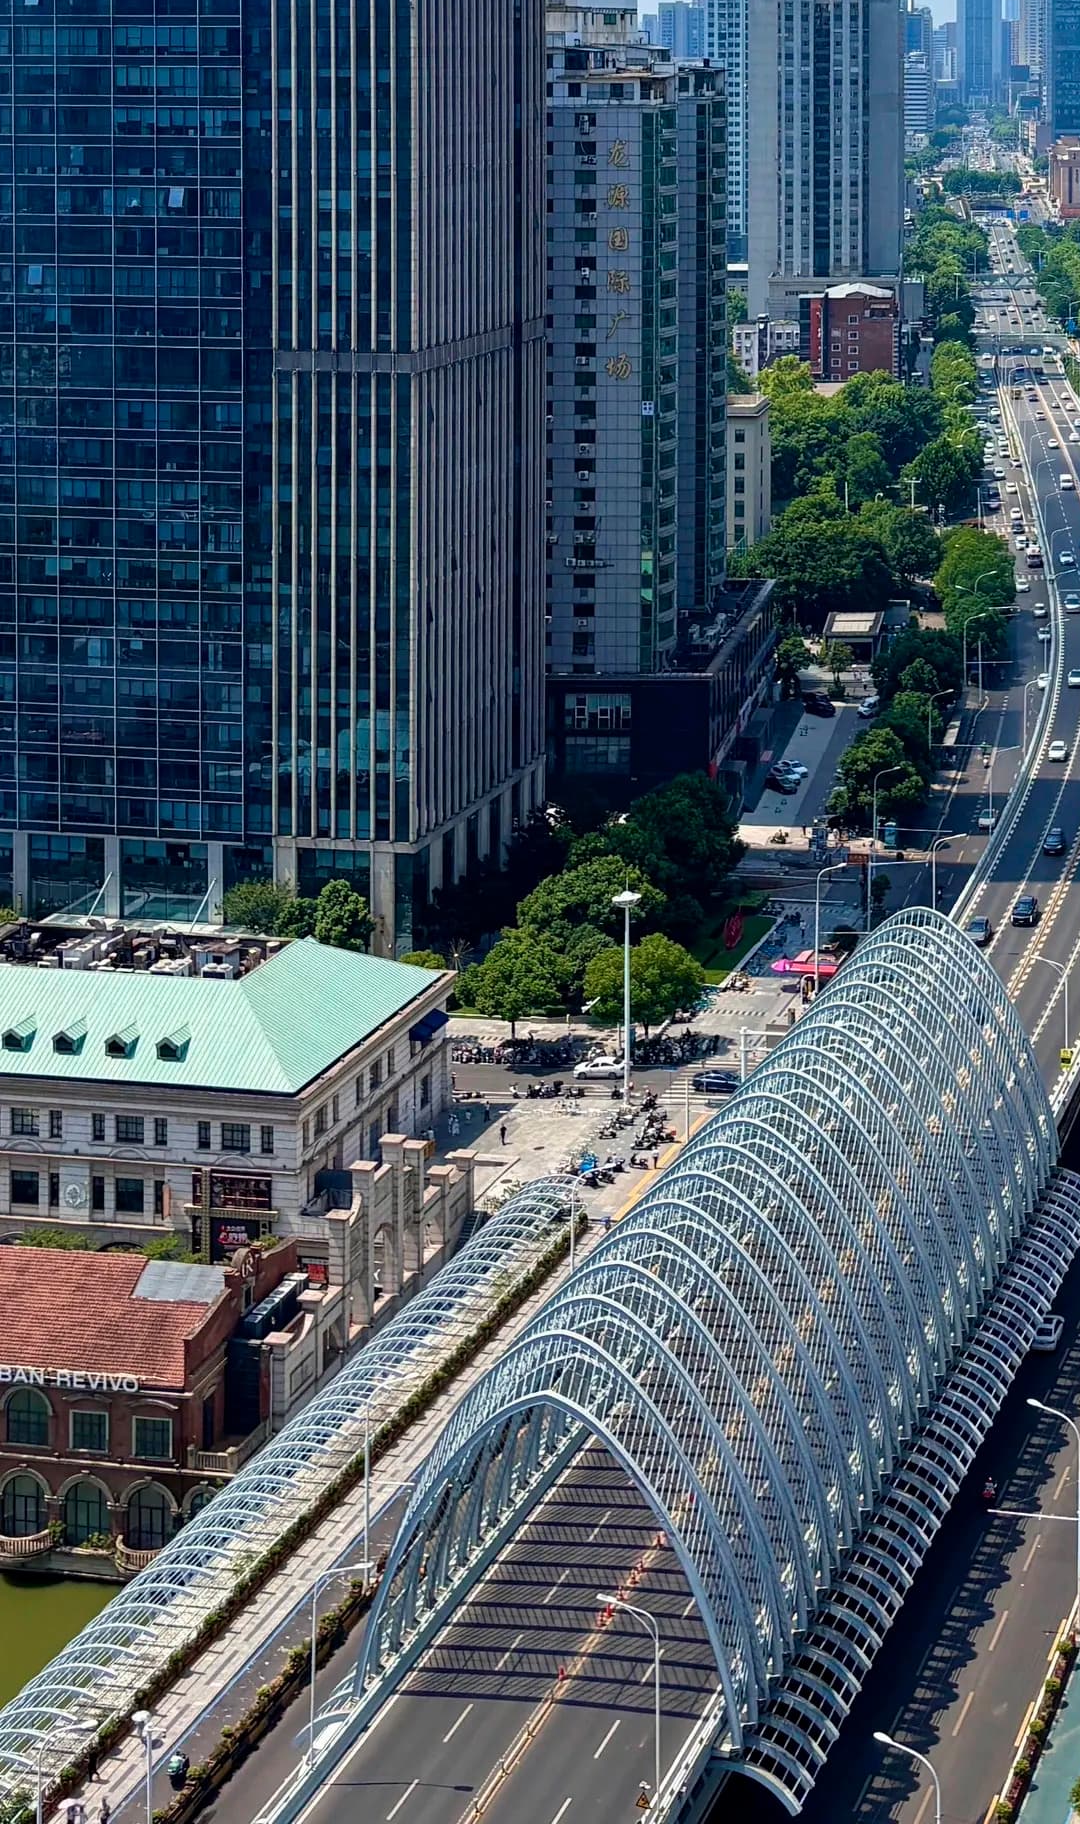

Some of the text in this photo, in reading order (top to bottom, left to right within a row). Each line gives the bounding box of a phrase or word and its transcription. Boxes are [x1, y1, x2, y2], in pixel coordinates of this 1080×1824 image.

[606, 139, 632, 380] 龙源国际广场
[56, 1371, 139, 1392] REVIVO
